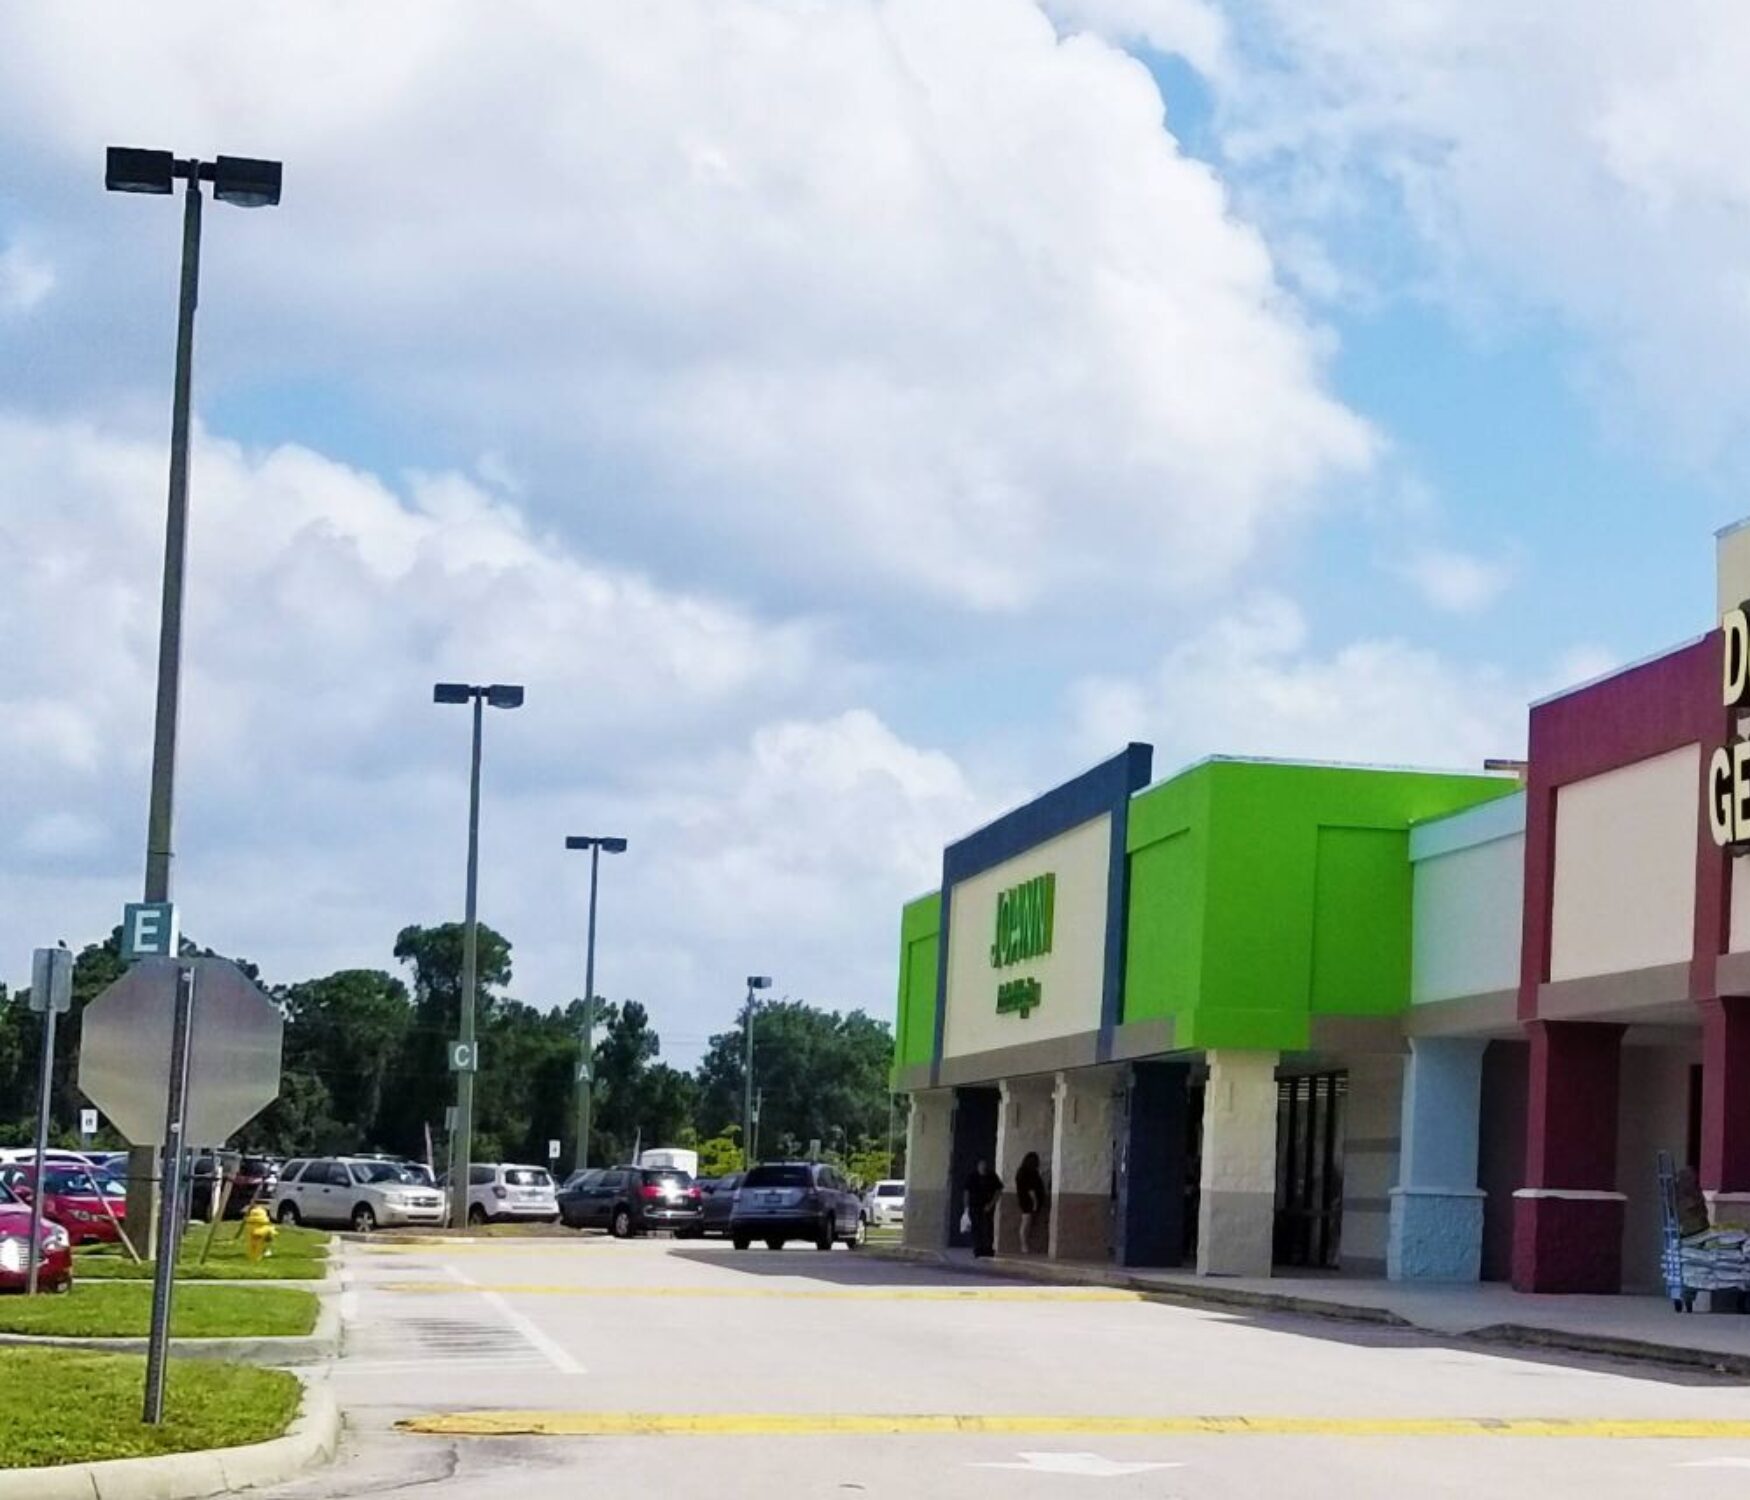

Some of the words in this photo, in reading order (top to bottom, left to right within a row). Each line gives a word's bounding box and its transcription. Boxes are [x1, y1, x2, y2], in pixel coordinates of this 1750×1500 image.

[133, 910, 161, 952] E
[454, 1044, 471, 1067] C
[578, 1063, 591, 1081] A
